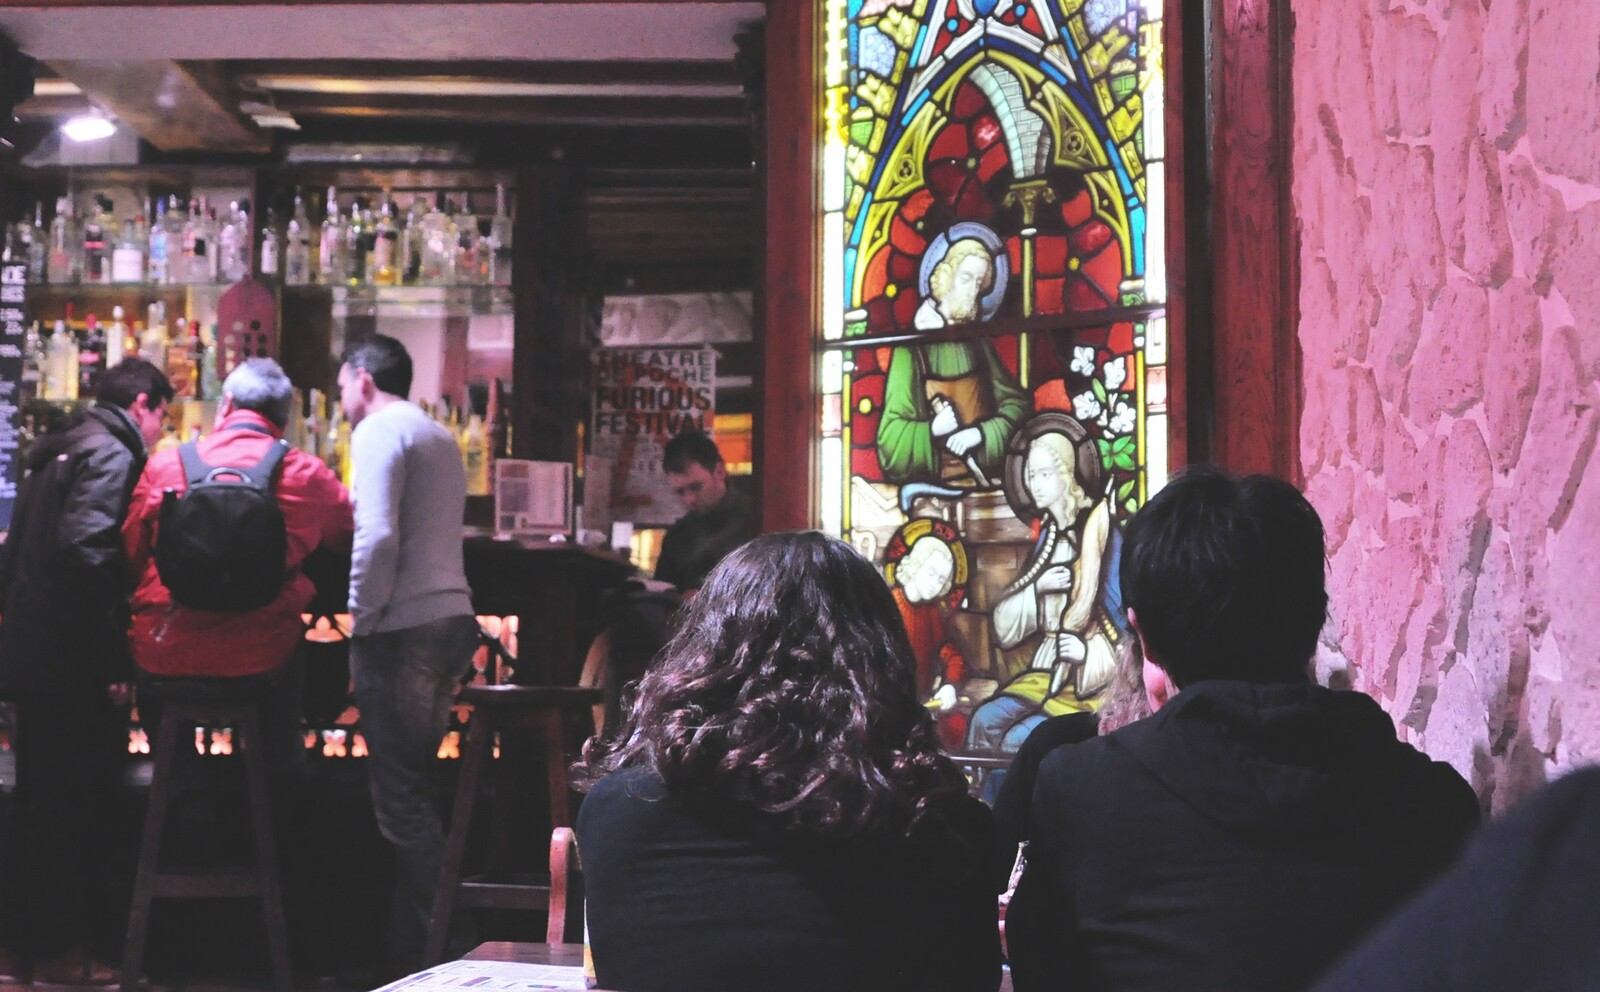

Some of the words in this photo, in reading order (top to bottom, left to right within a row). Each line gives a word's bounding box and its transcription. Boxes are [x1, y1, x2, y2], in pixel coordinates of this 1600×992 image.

[598, 350, 711, 366] THEATRE
[634, 366, 711, 383] POCHE
[596, 386, 711, 410] FURIOUS
[596, 411, 709, 435] FESTIVAL
